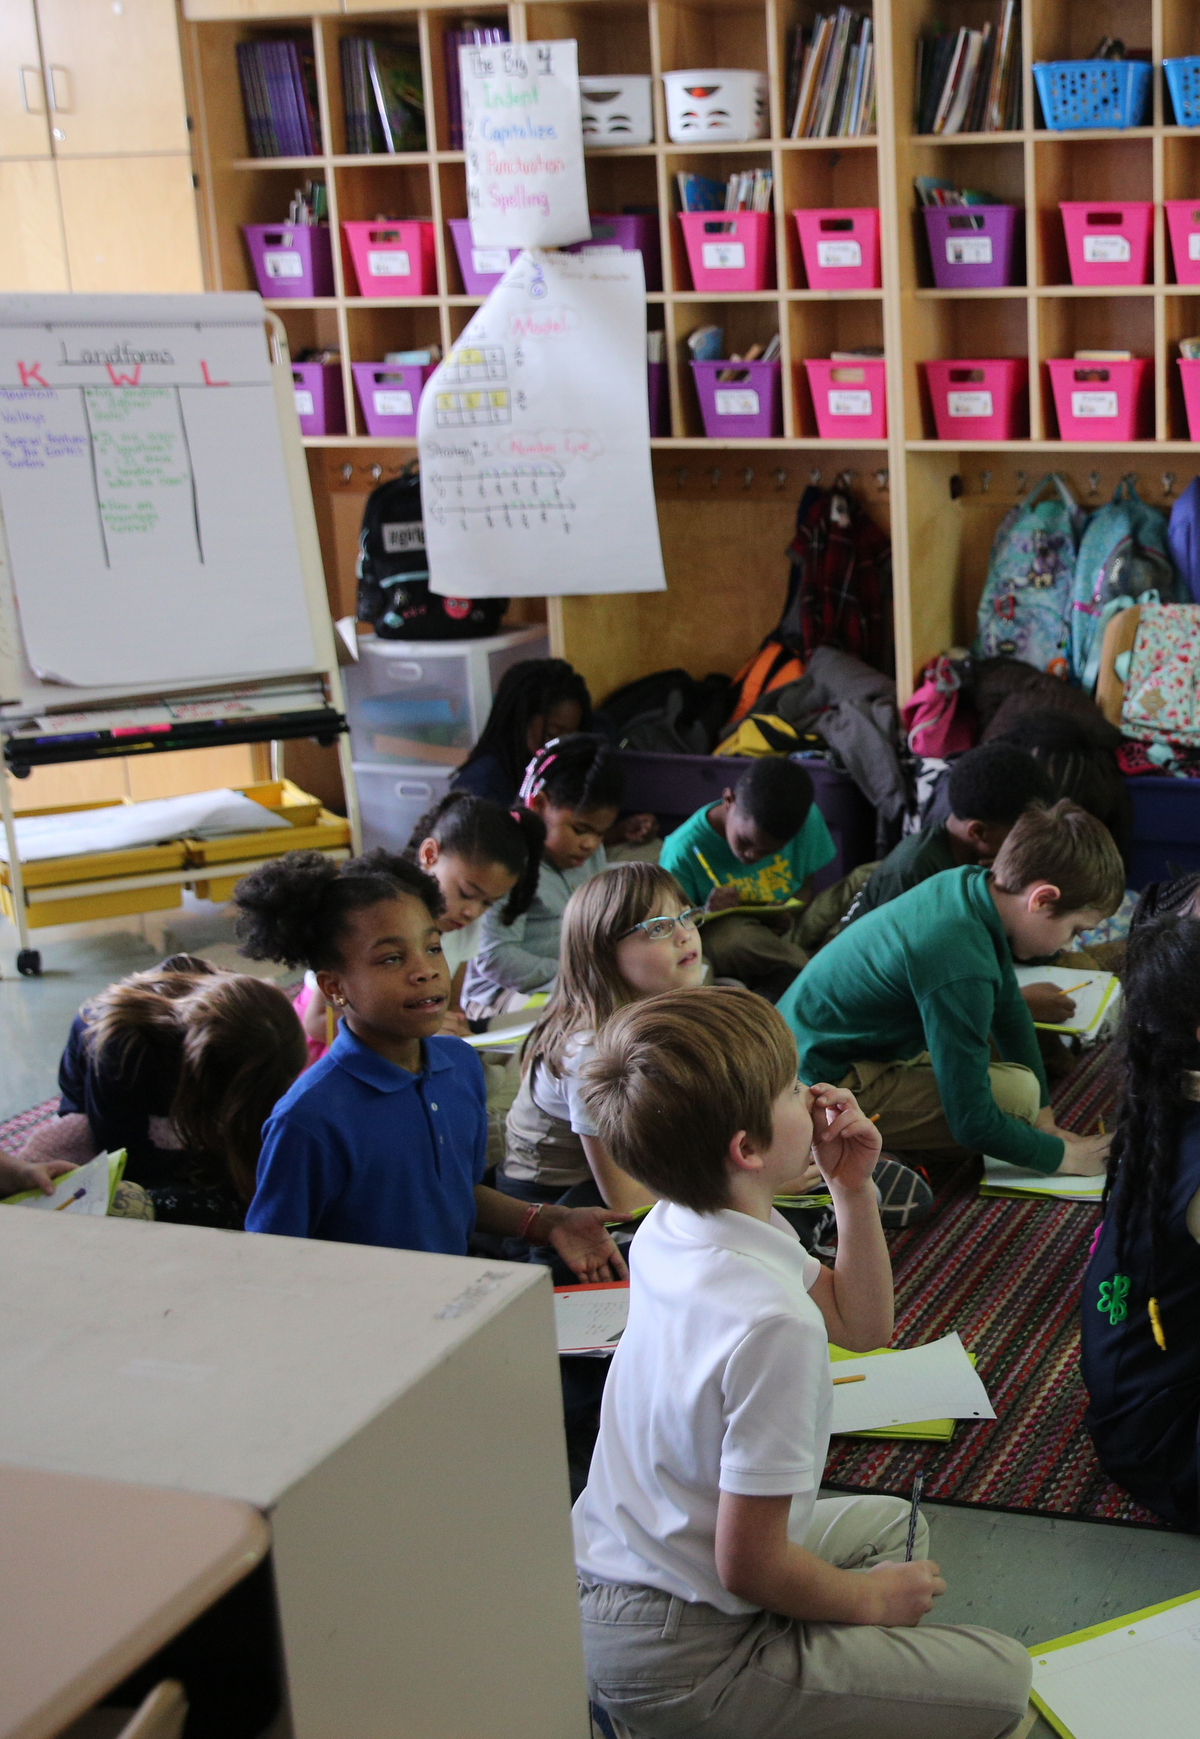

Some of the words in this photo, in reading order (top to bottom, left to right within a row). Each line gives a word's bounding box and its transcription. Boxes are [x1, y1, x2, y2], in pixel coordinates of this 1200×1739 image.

[469, 49, 495, 76] The
[503, 48, 529, 78] Big
[538, 46, 554, 75] 4
[483, 81, 540, 109] Indent
[480, 116, 559, 147] Capitalize
[486, 150, 566, 176] Punctuation
[487, 183, 551, 217] Spelling
[512, 315, 567, 336] Model
[60, 340, 175, 365] Landforms
[17, 360, 50, 388] K
[107, 361, 142, 387] W
[200, 359, 230, 387] L
[510, 440, 557, 456] Number
